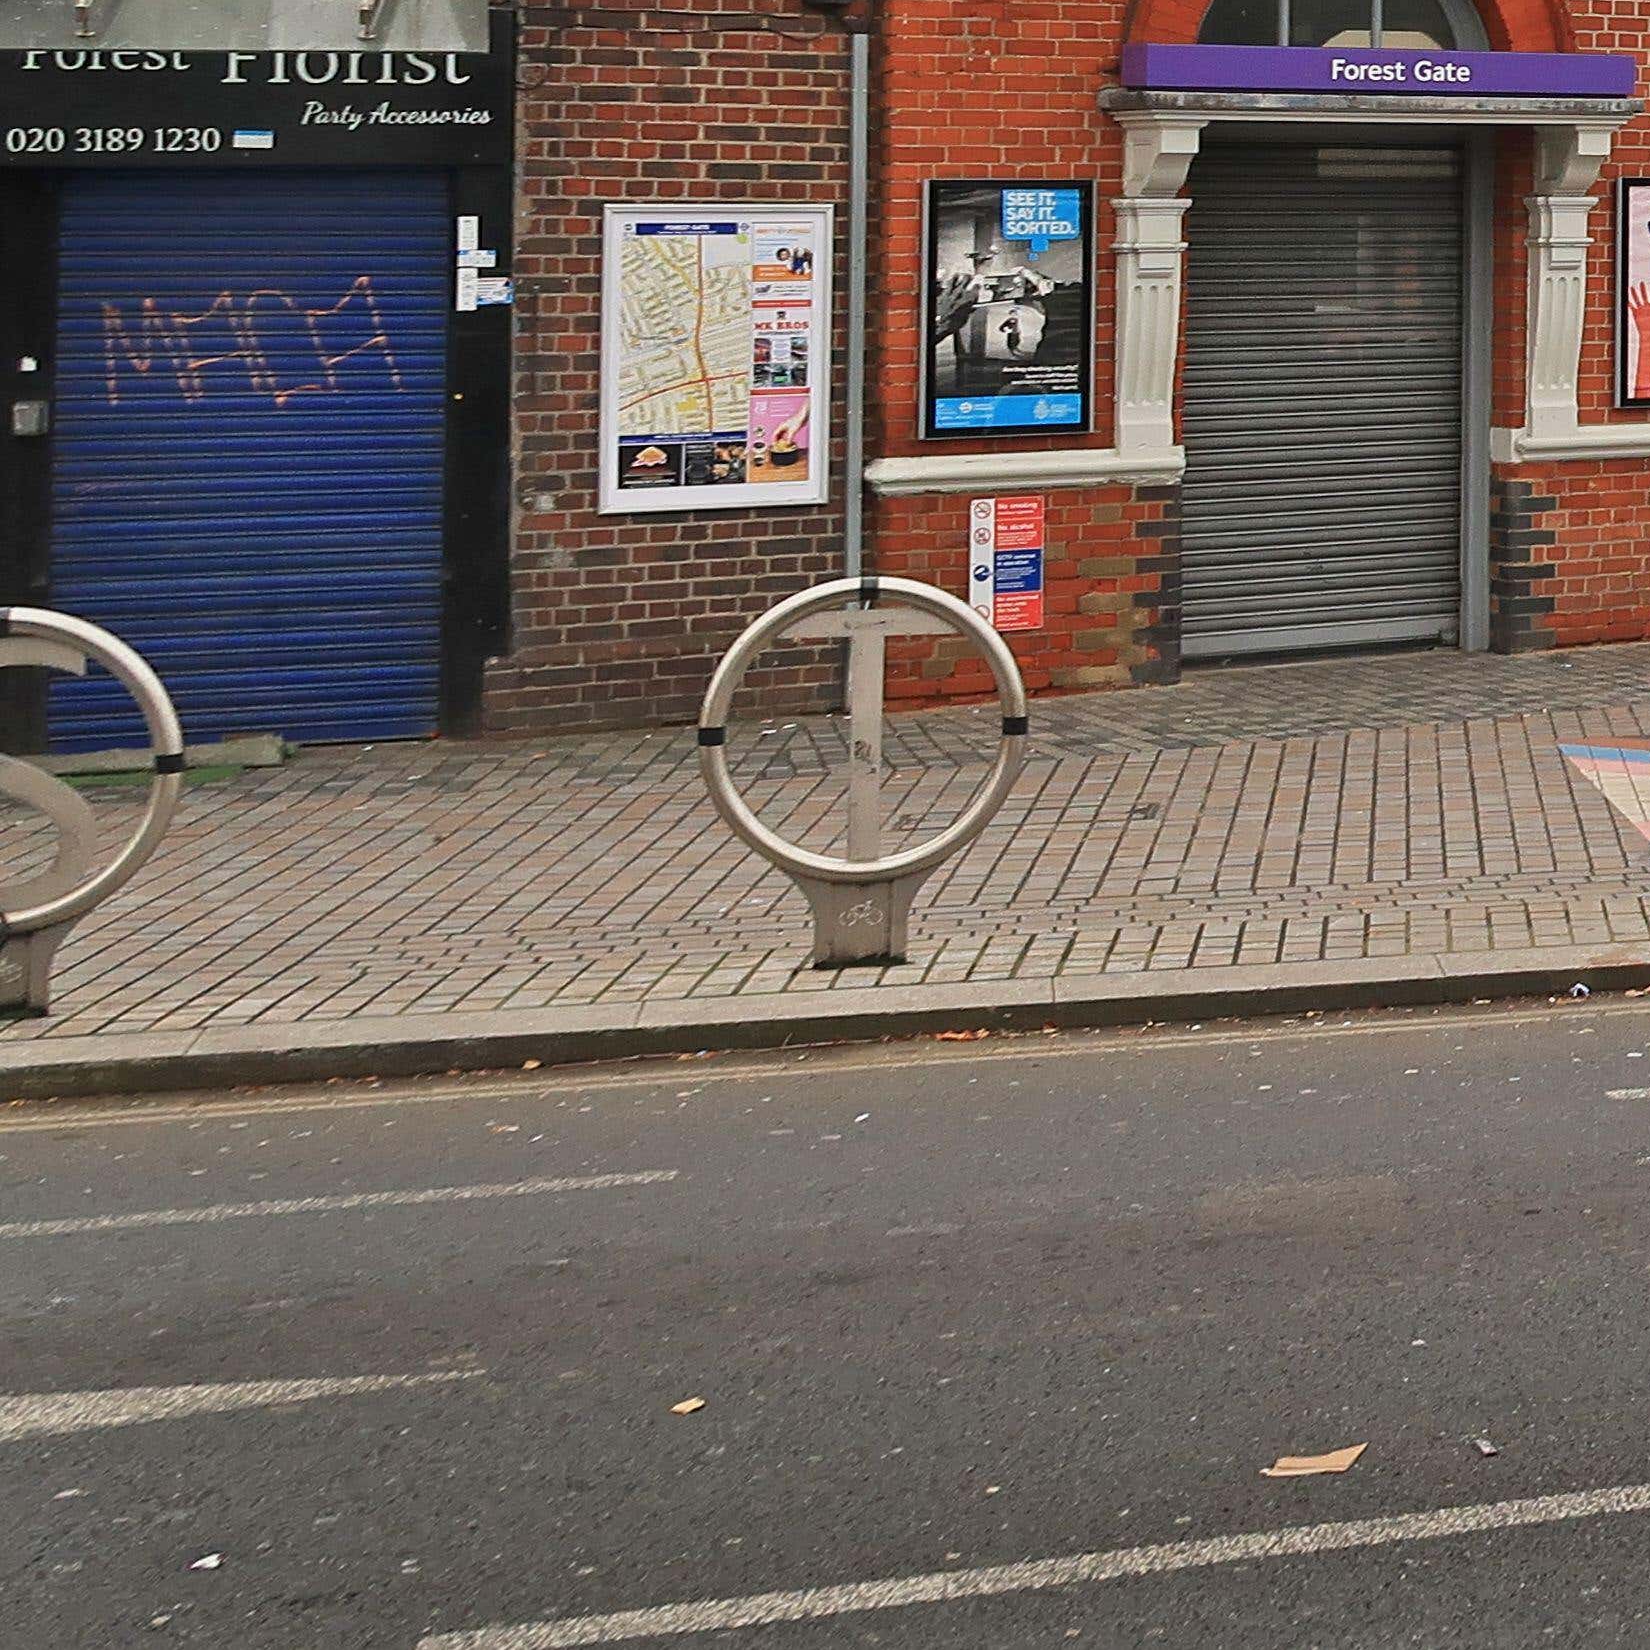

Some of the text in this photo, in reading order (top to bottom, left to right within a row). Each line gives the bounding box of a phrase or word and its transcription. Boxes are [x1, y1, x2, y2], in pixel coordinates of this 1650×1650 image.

[1331, 58, 1471, 82] Forest Gate
[300, 100, 493, 131] Party Accessories
[6, 128, 222, 153] 020 3189 1230
[1007, 192, 1056, 206] SEE IT.
[1007, 207, 1056, 220] SAY IT.
[1007, 221, 1076, 235] SORTED.
